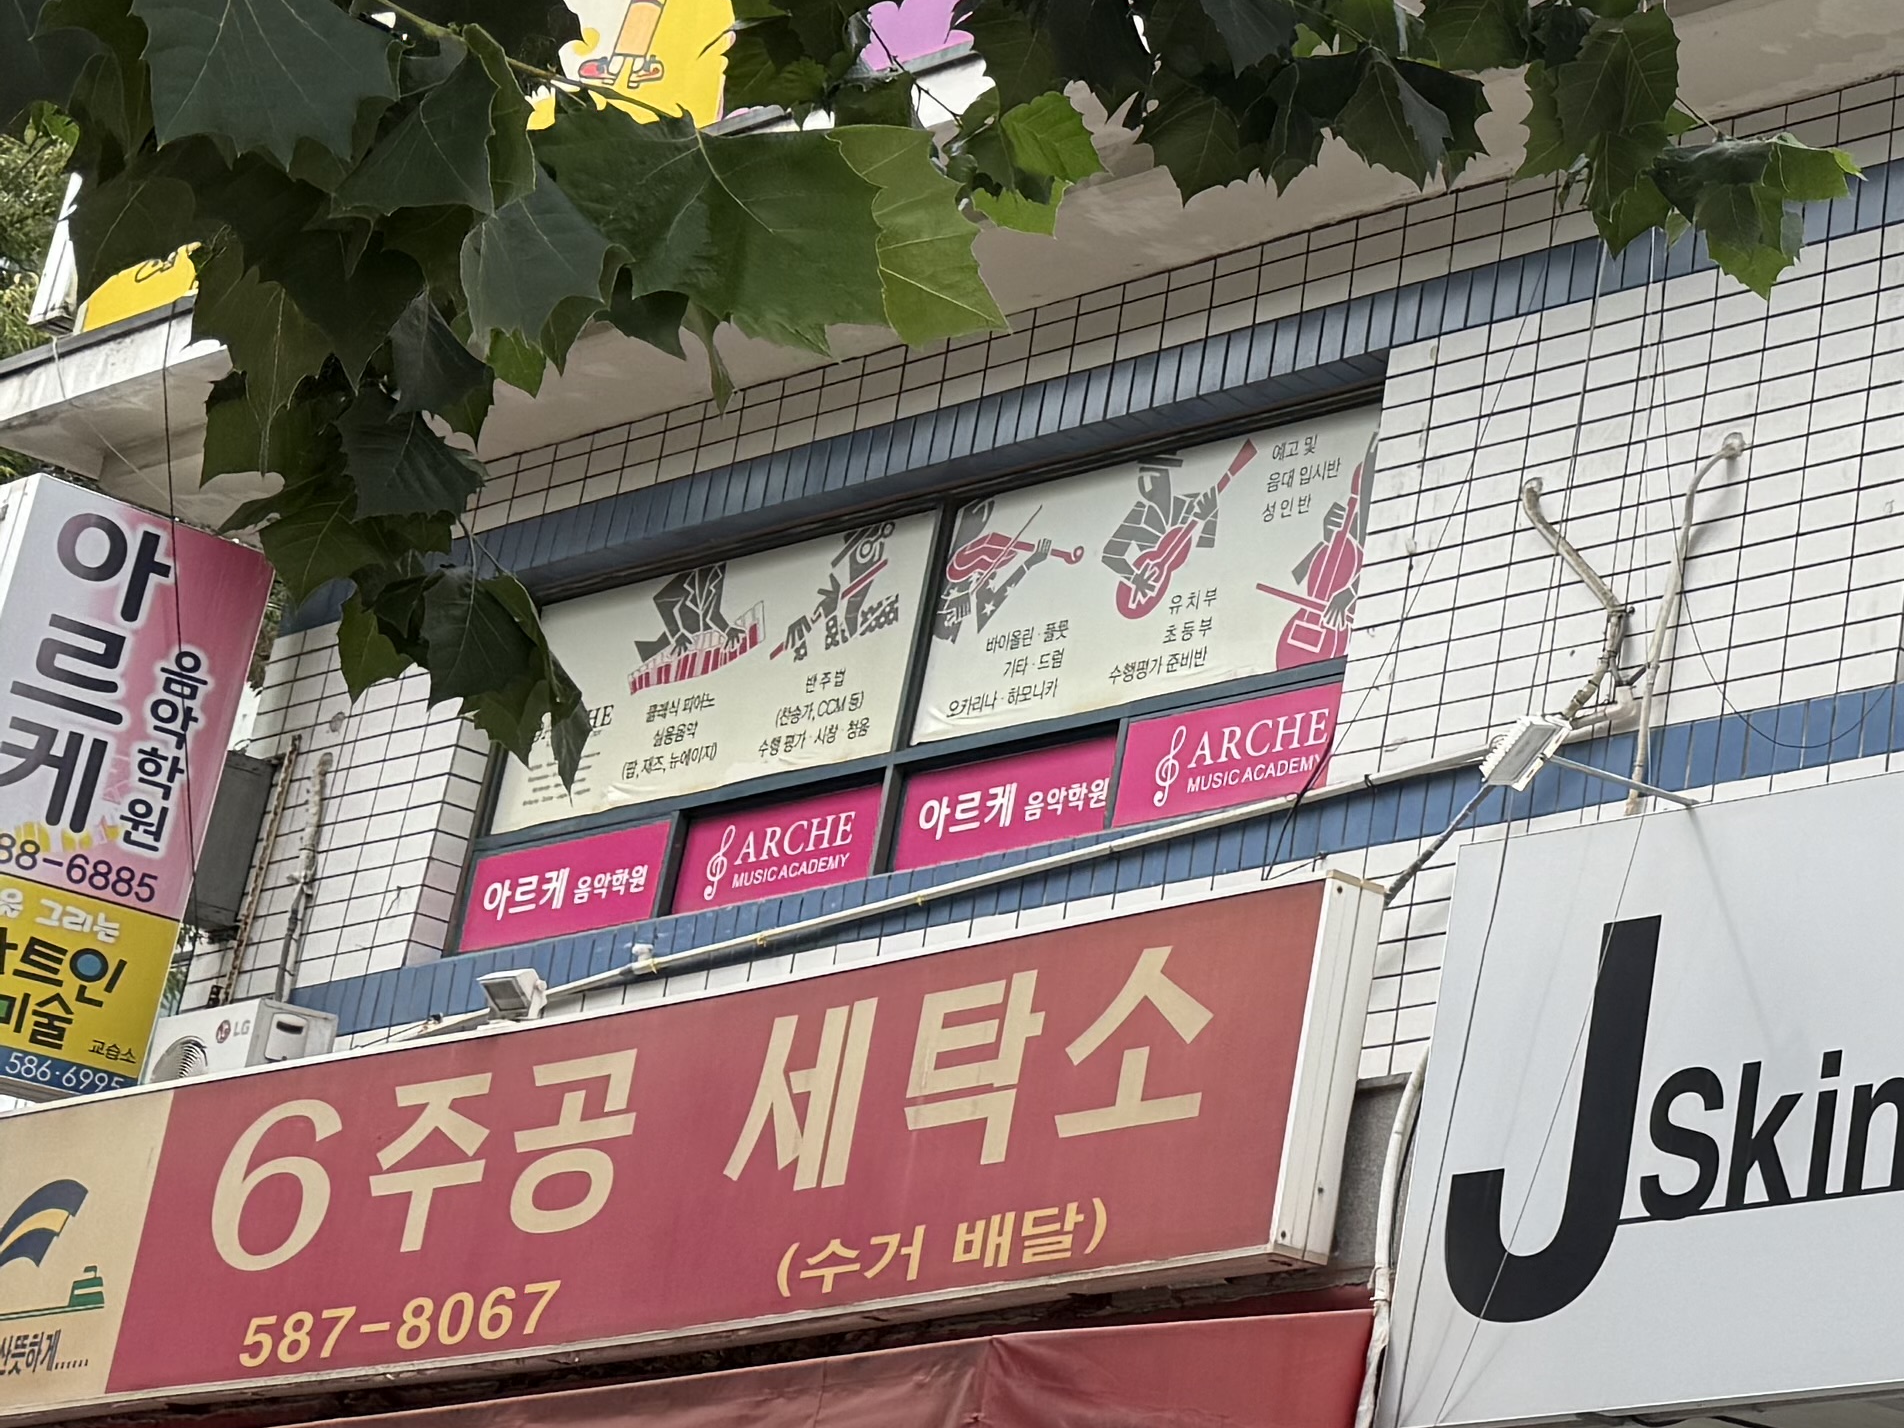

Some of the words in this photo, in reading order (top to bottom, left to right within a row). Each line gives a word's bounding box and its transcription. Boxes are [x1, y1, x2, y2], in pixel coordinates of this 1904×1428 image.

[1267, 470, 1295, 493] 음대
[1299, 458, 1341, 486] 입시반
[1272, 439, 1300, 462] 예고
[0, 512, 173, 834] 아르케
[120, 651, 208, 853] 음악학원
[1188, 706, 1330, 767] ARCHE
[917, 782, 1014, 842] 아르케
[1023, 774, 1110, 823] 음악학원
[734, 811, 856, 865] ARCHE
[36, 898, 120, 944] 그리는
[483, 867, 571, 920] 아르케
[574, 865, 648, 904] 음악학원
[89, 1040, 136, 1063] 교습소
[232, 1020, 250, 1037] LG
[209, 1046, 641, 1274] 6주공
[723, 944, 1216, 1196] 세탁소
[774, 1224, 924, 1301] (수거
[954, 1197, 1109, 1271] 배달)
[239, 1281, 562, 1370] 587-8067
